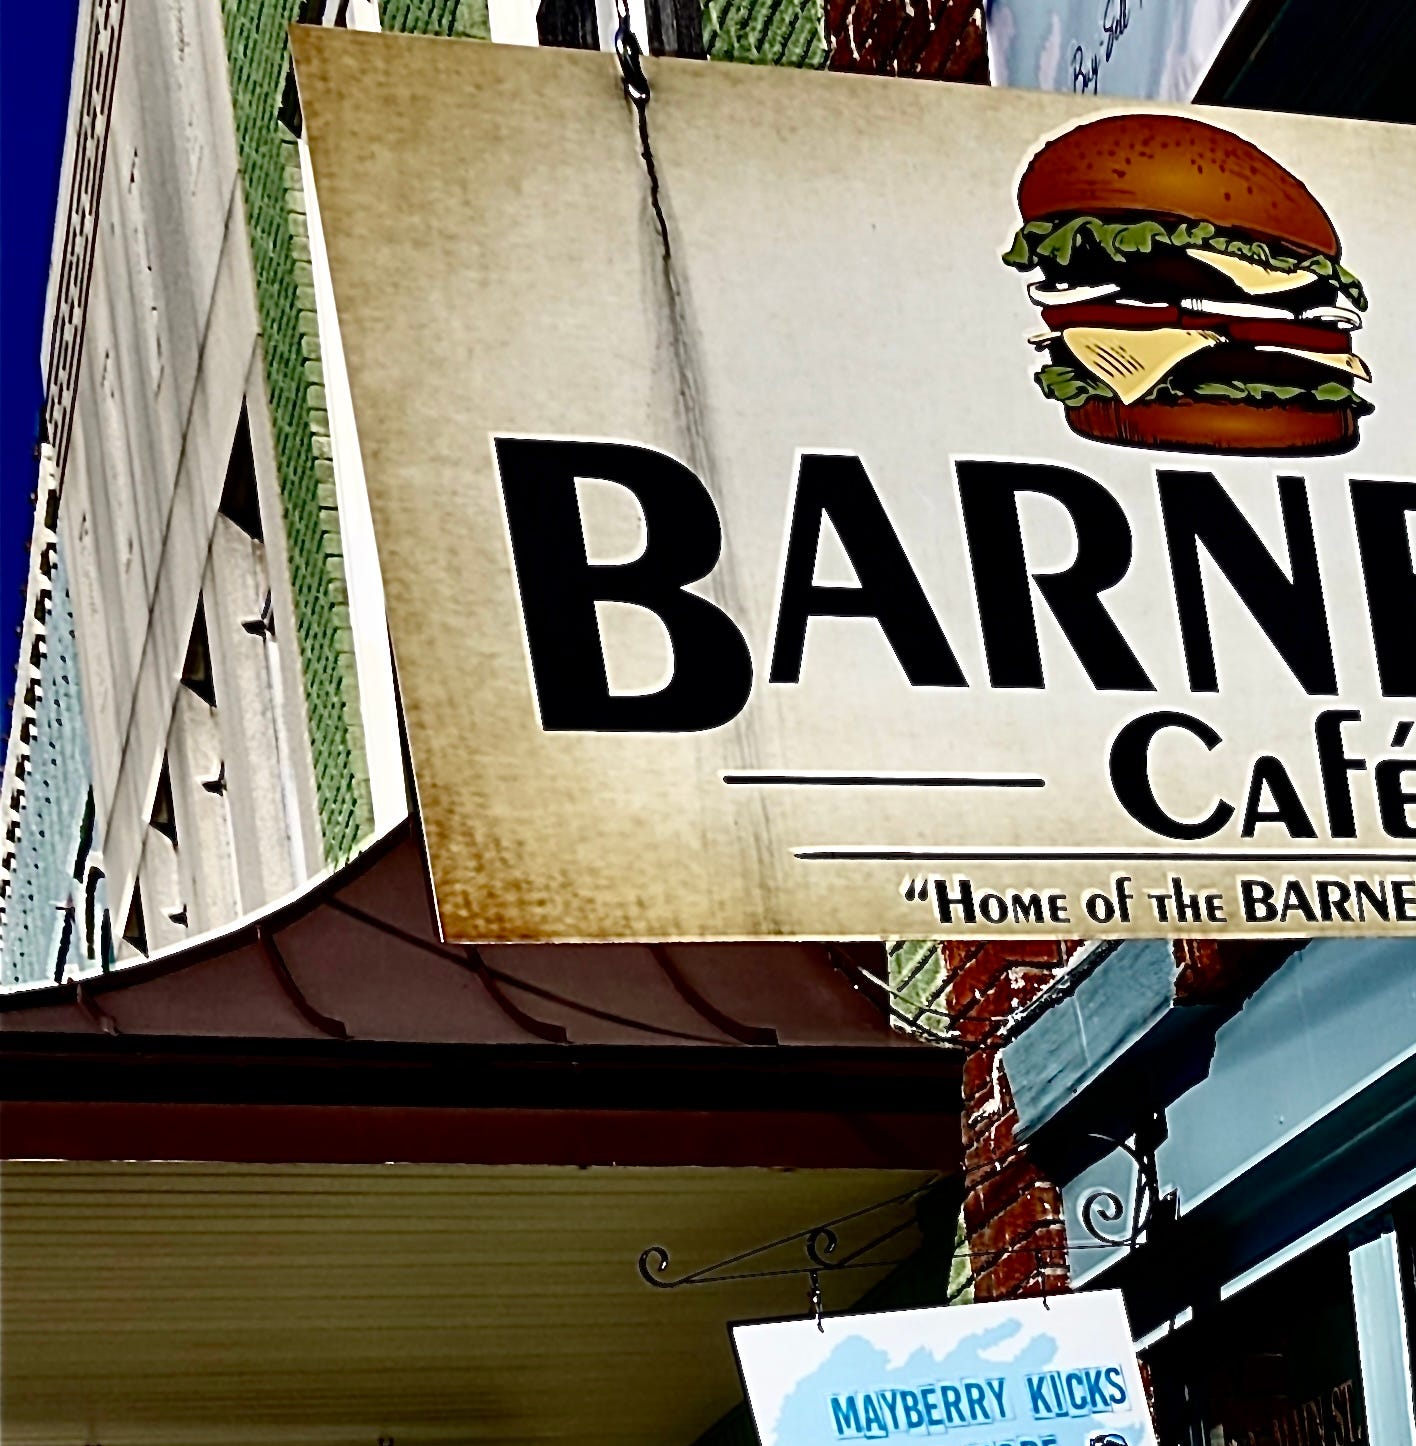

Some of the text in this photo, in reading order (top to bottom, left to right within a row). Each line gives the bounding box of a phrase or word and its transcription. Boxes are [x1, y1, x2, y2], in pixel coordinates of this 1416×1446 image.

[1085, 876, 1134, 923] of
[832, 1366, 1127, 1437] MAYBERRY KICKS
